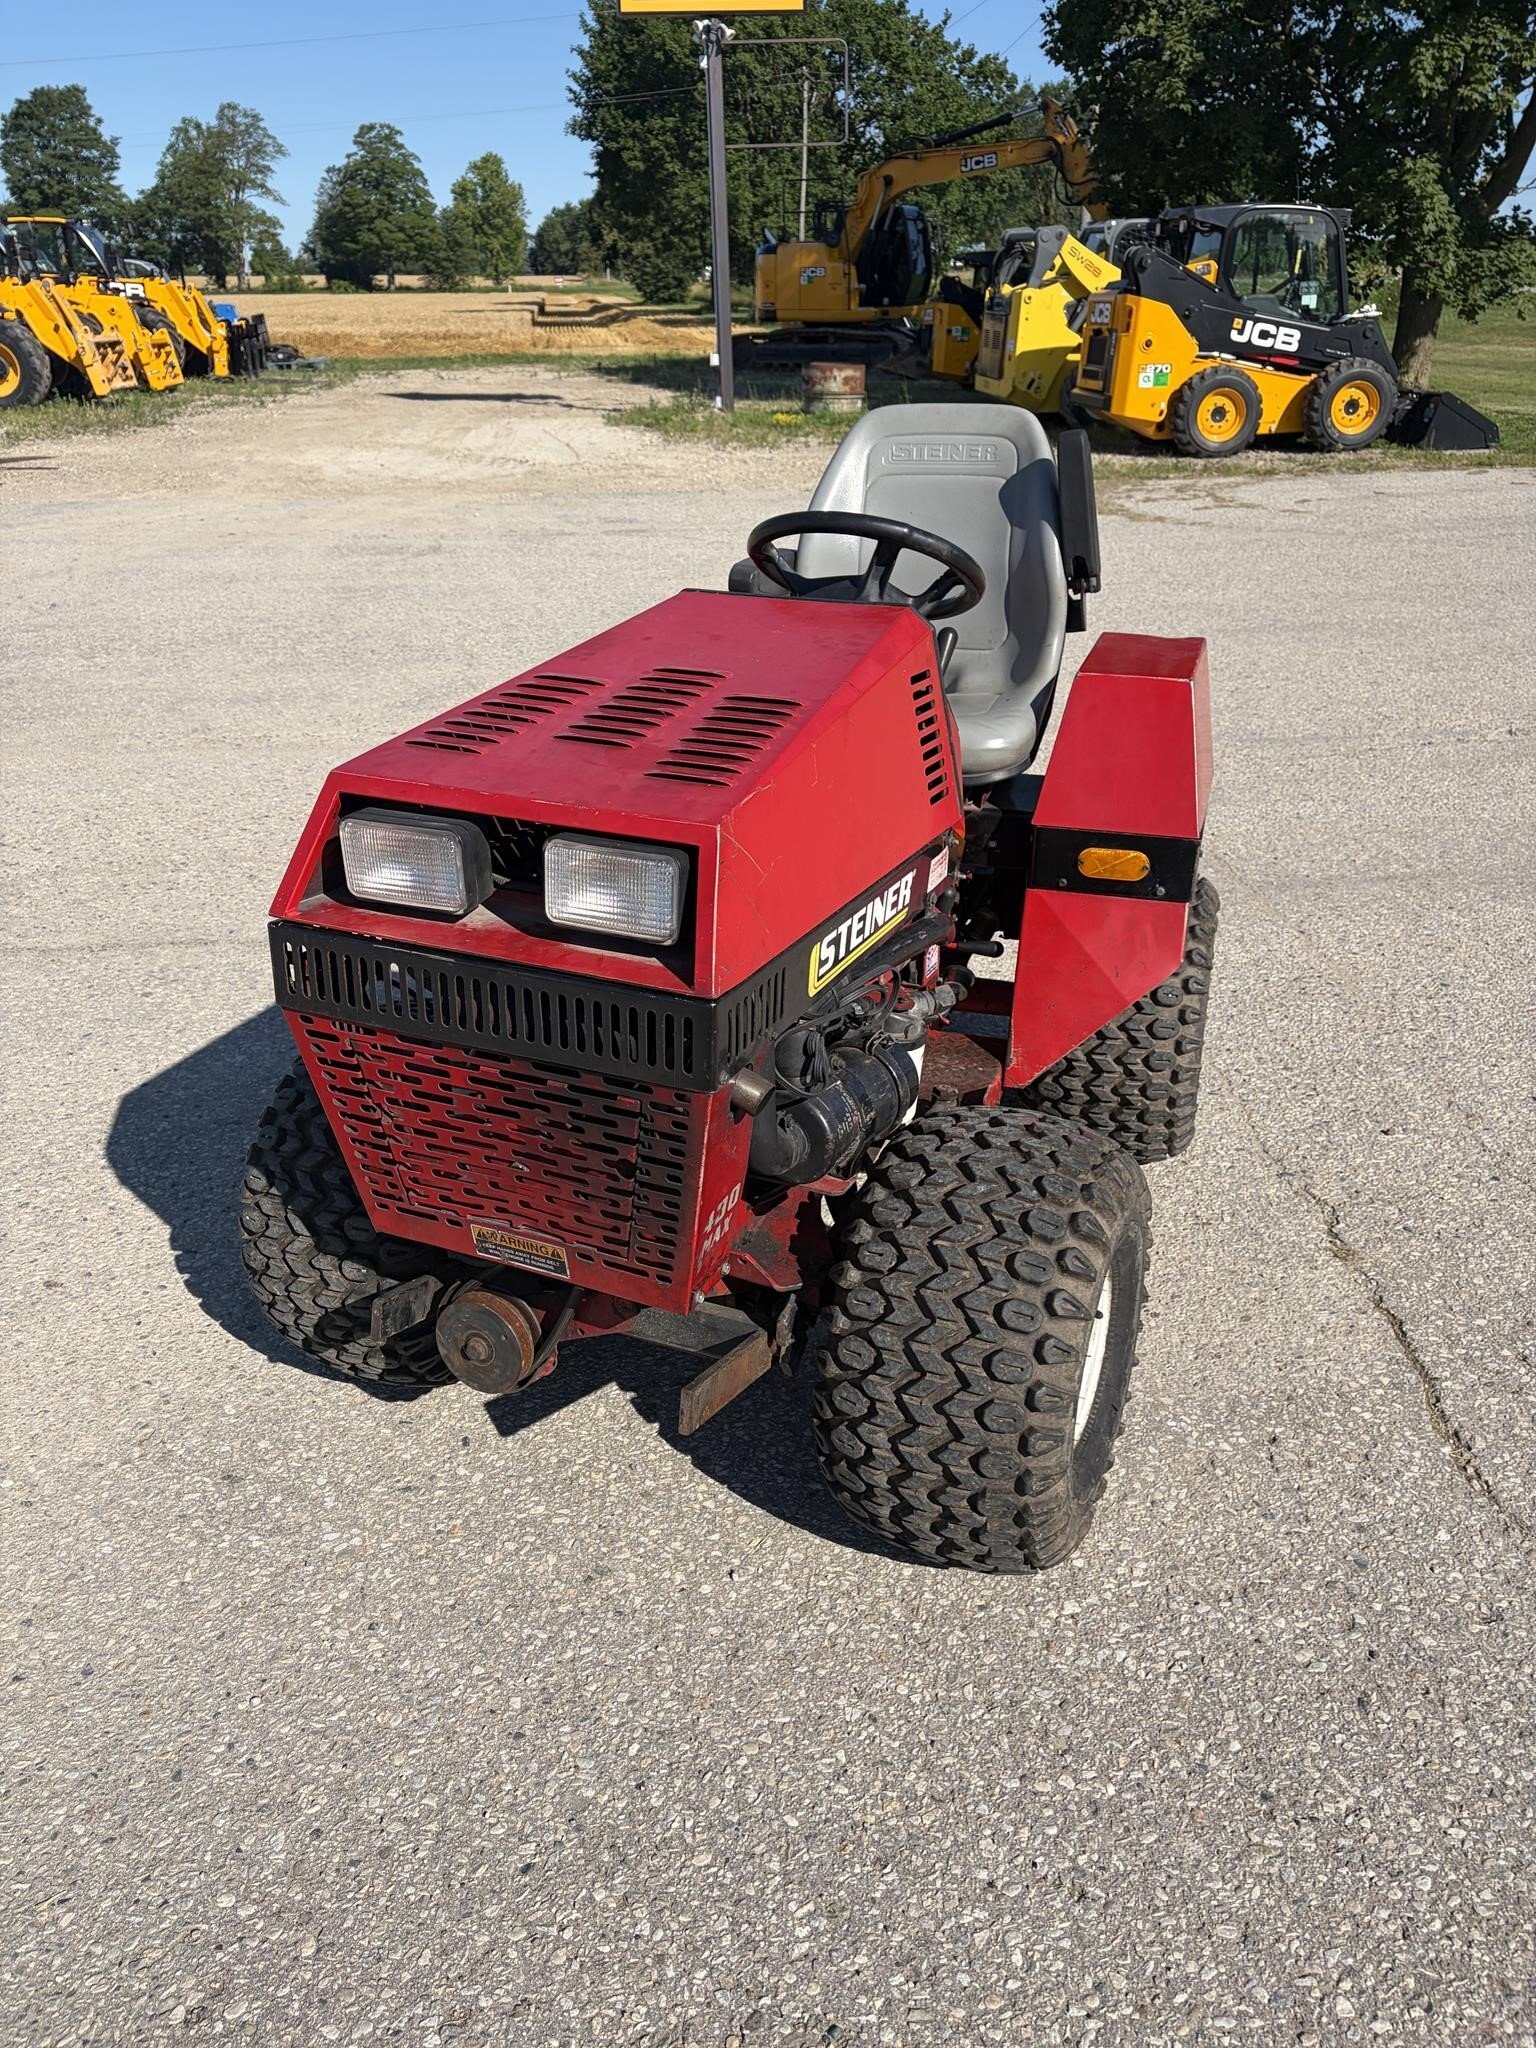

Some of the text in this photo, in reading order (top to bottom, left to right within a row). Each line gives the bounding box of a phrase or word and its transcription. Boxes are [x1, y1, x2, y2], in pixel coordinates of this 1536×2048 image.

[960, 153, 997, 171] JCB
[800, 267, 825, 276] JCB
[1091, 303, 1111, 323] JCB
[1230, 318, 1301, 352] JCB
[892, 444, 997, 462] STEINER
[819, 870, 913, 977] STEINER
[704, 1182, 741, 1233] 430
[485, 1230, 549, 1255] WARNING
[701, 1212, 732, 1254] MAX
